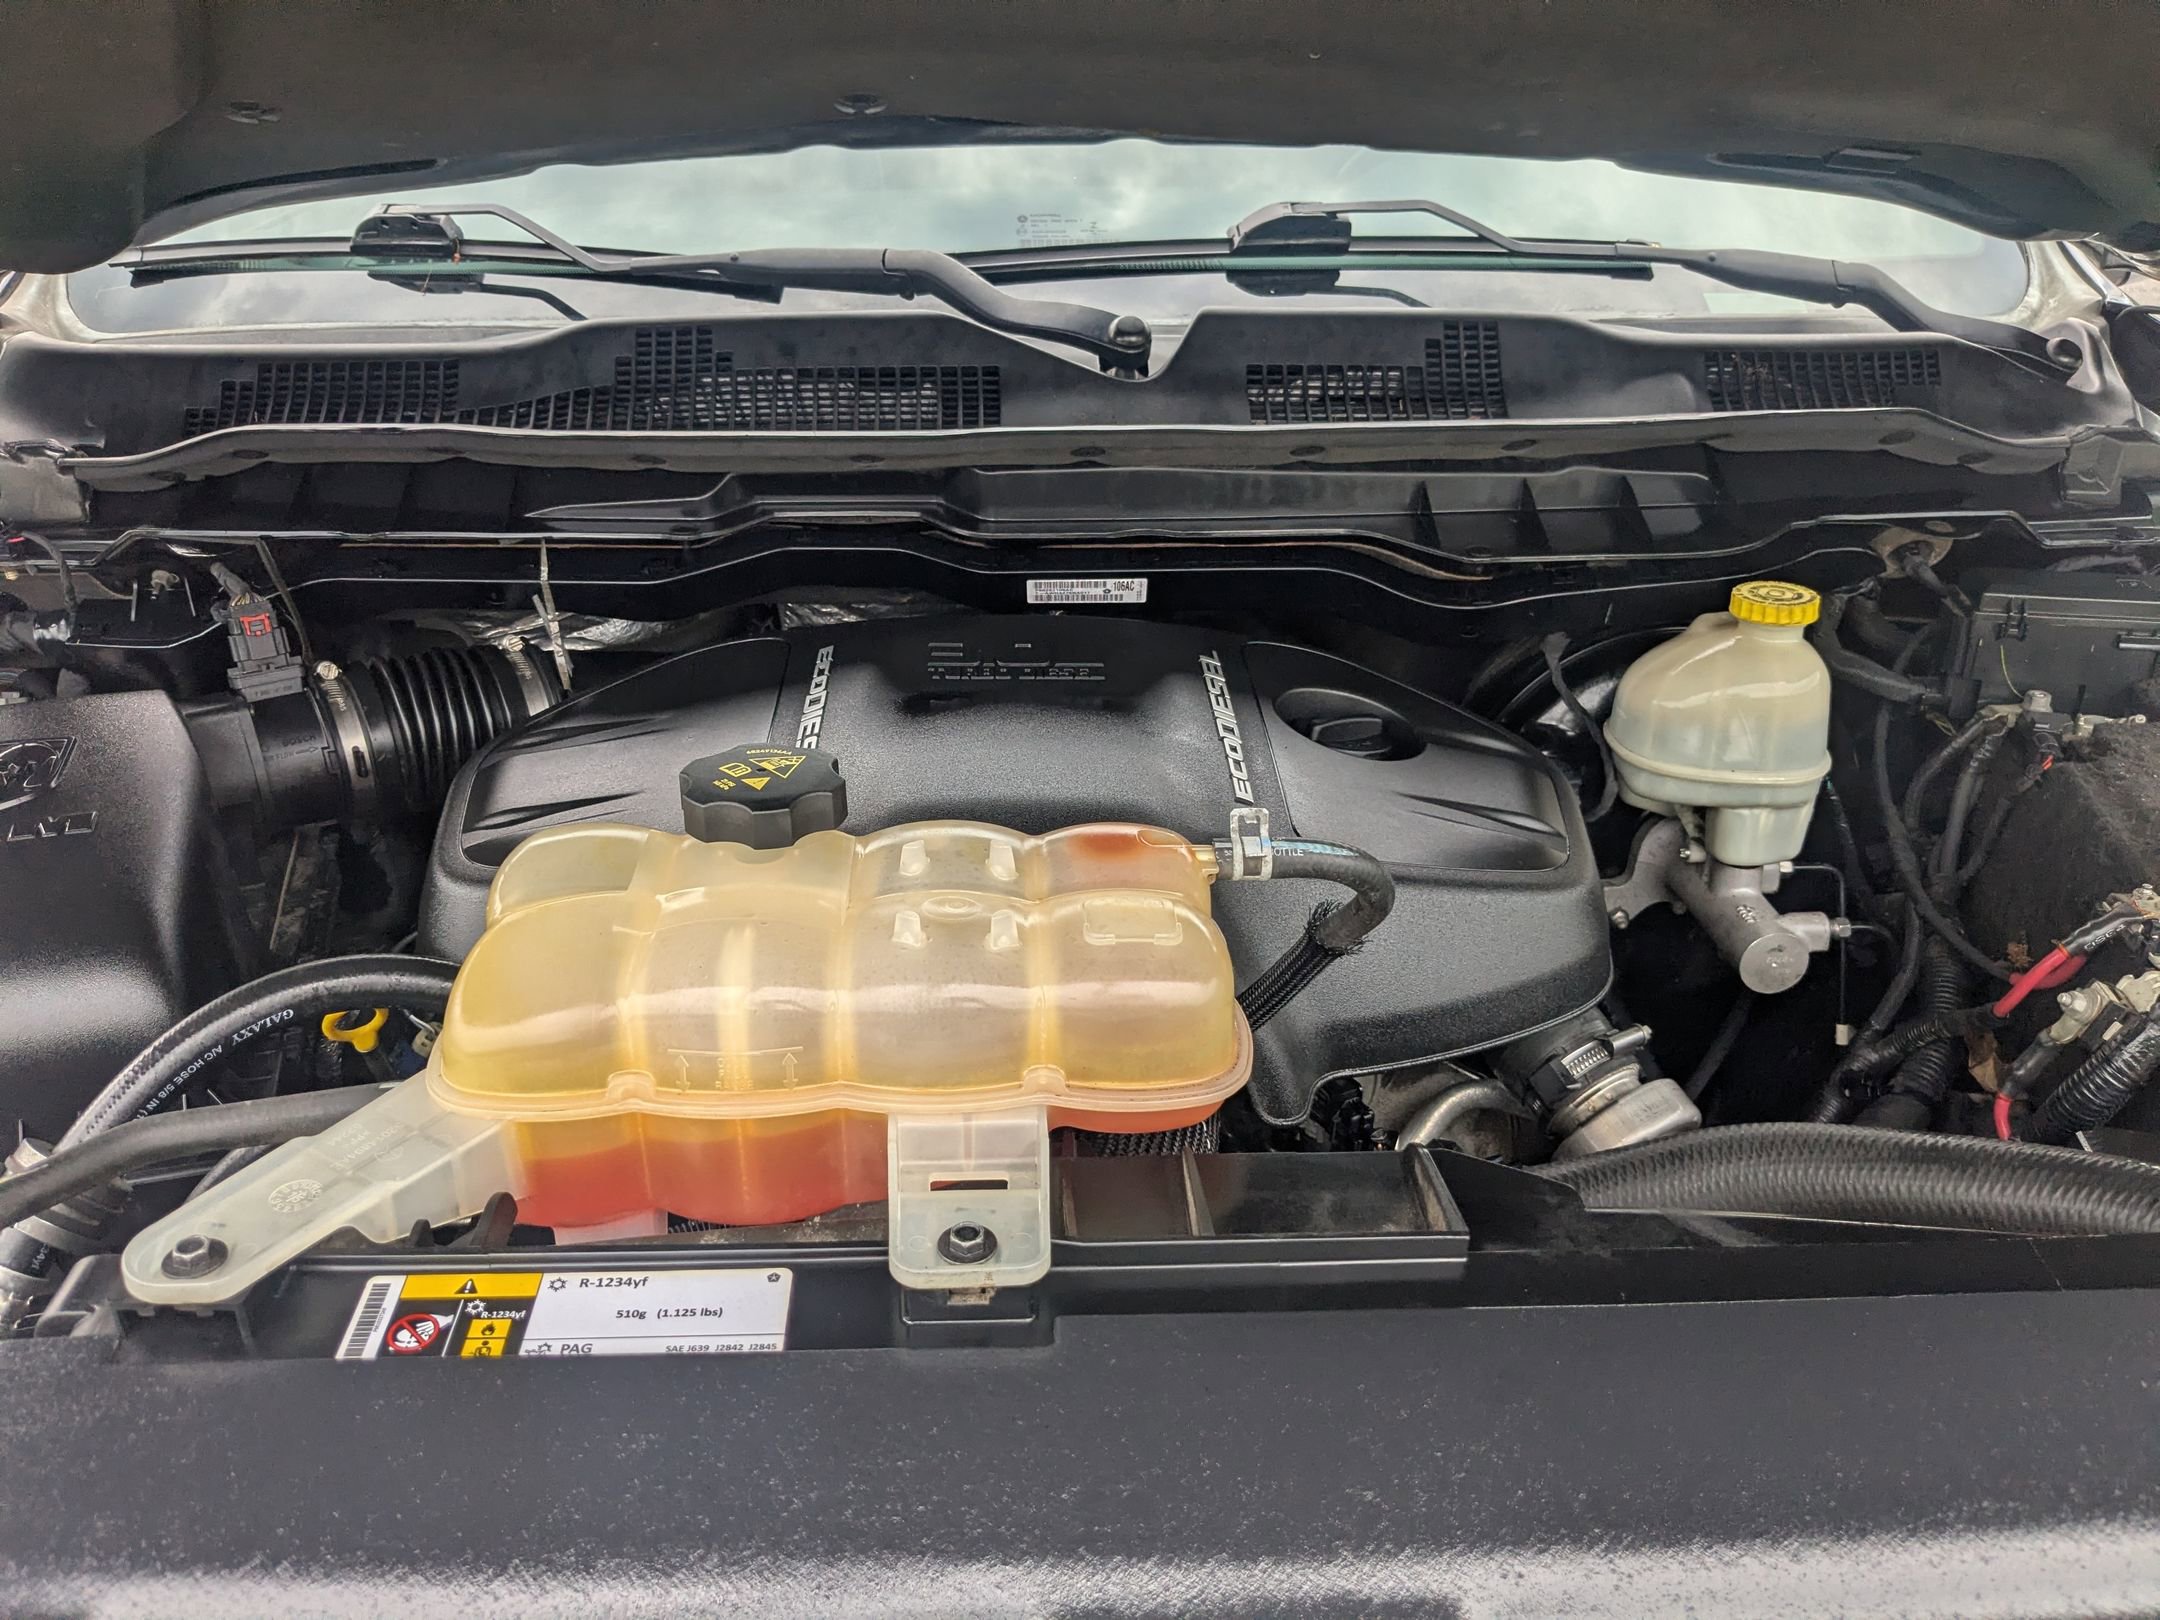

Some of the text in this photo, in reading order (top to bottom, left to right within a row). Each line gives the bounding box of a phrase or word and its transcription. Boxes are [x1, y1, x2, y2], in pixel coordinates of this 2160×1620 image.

[1113, 580, 1135, 592] 106AC
[796, 645, 834, 749] ECODIES
[1198, 650, 1254, 804] ECODIESEL
[230, 1007, 295, 1046] GALAXY
[204, 1044, 223, 1062] A/C
[173, 1058, 205, 1086] HOSE
[157, 1085, 176, 1099] 5/8
[145, 1098, 160, 1111] IN
[579, 1276, 649, 1290] R-1234yf
[480, 1309, 527, 1321] R-1234yf
[615, 1306, 724, 1320] 510g (1.125 lbs)
[560, 1343, 594, 1354] PAG
[665, 1342, 777, 1353] SAE J639 J2842 J2845
